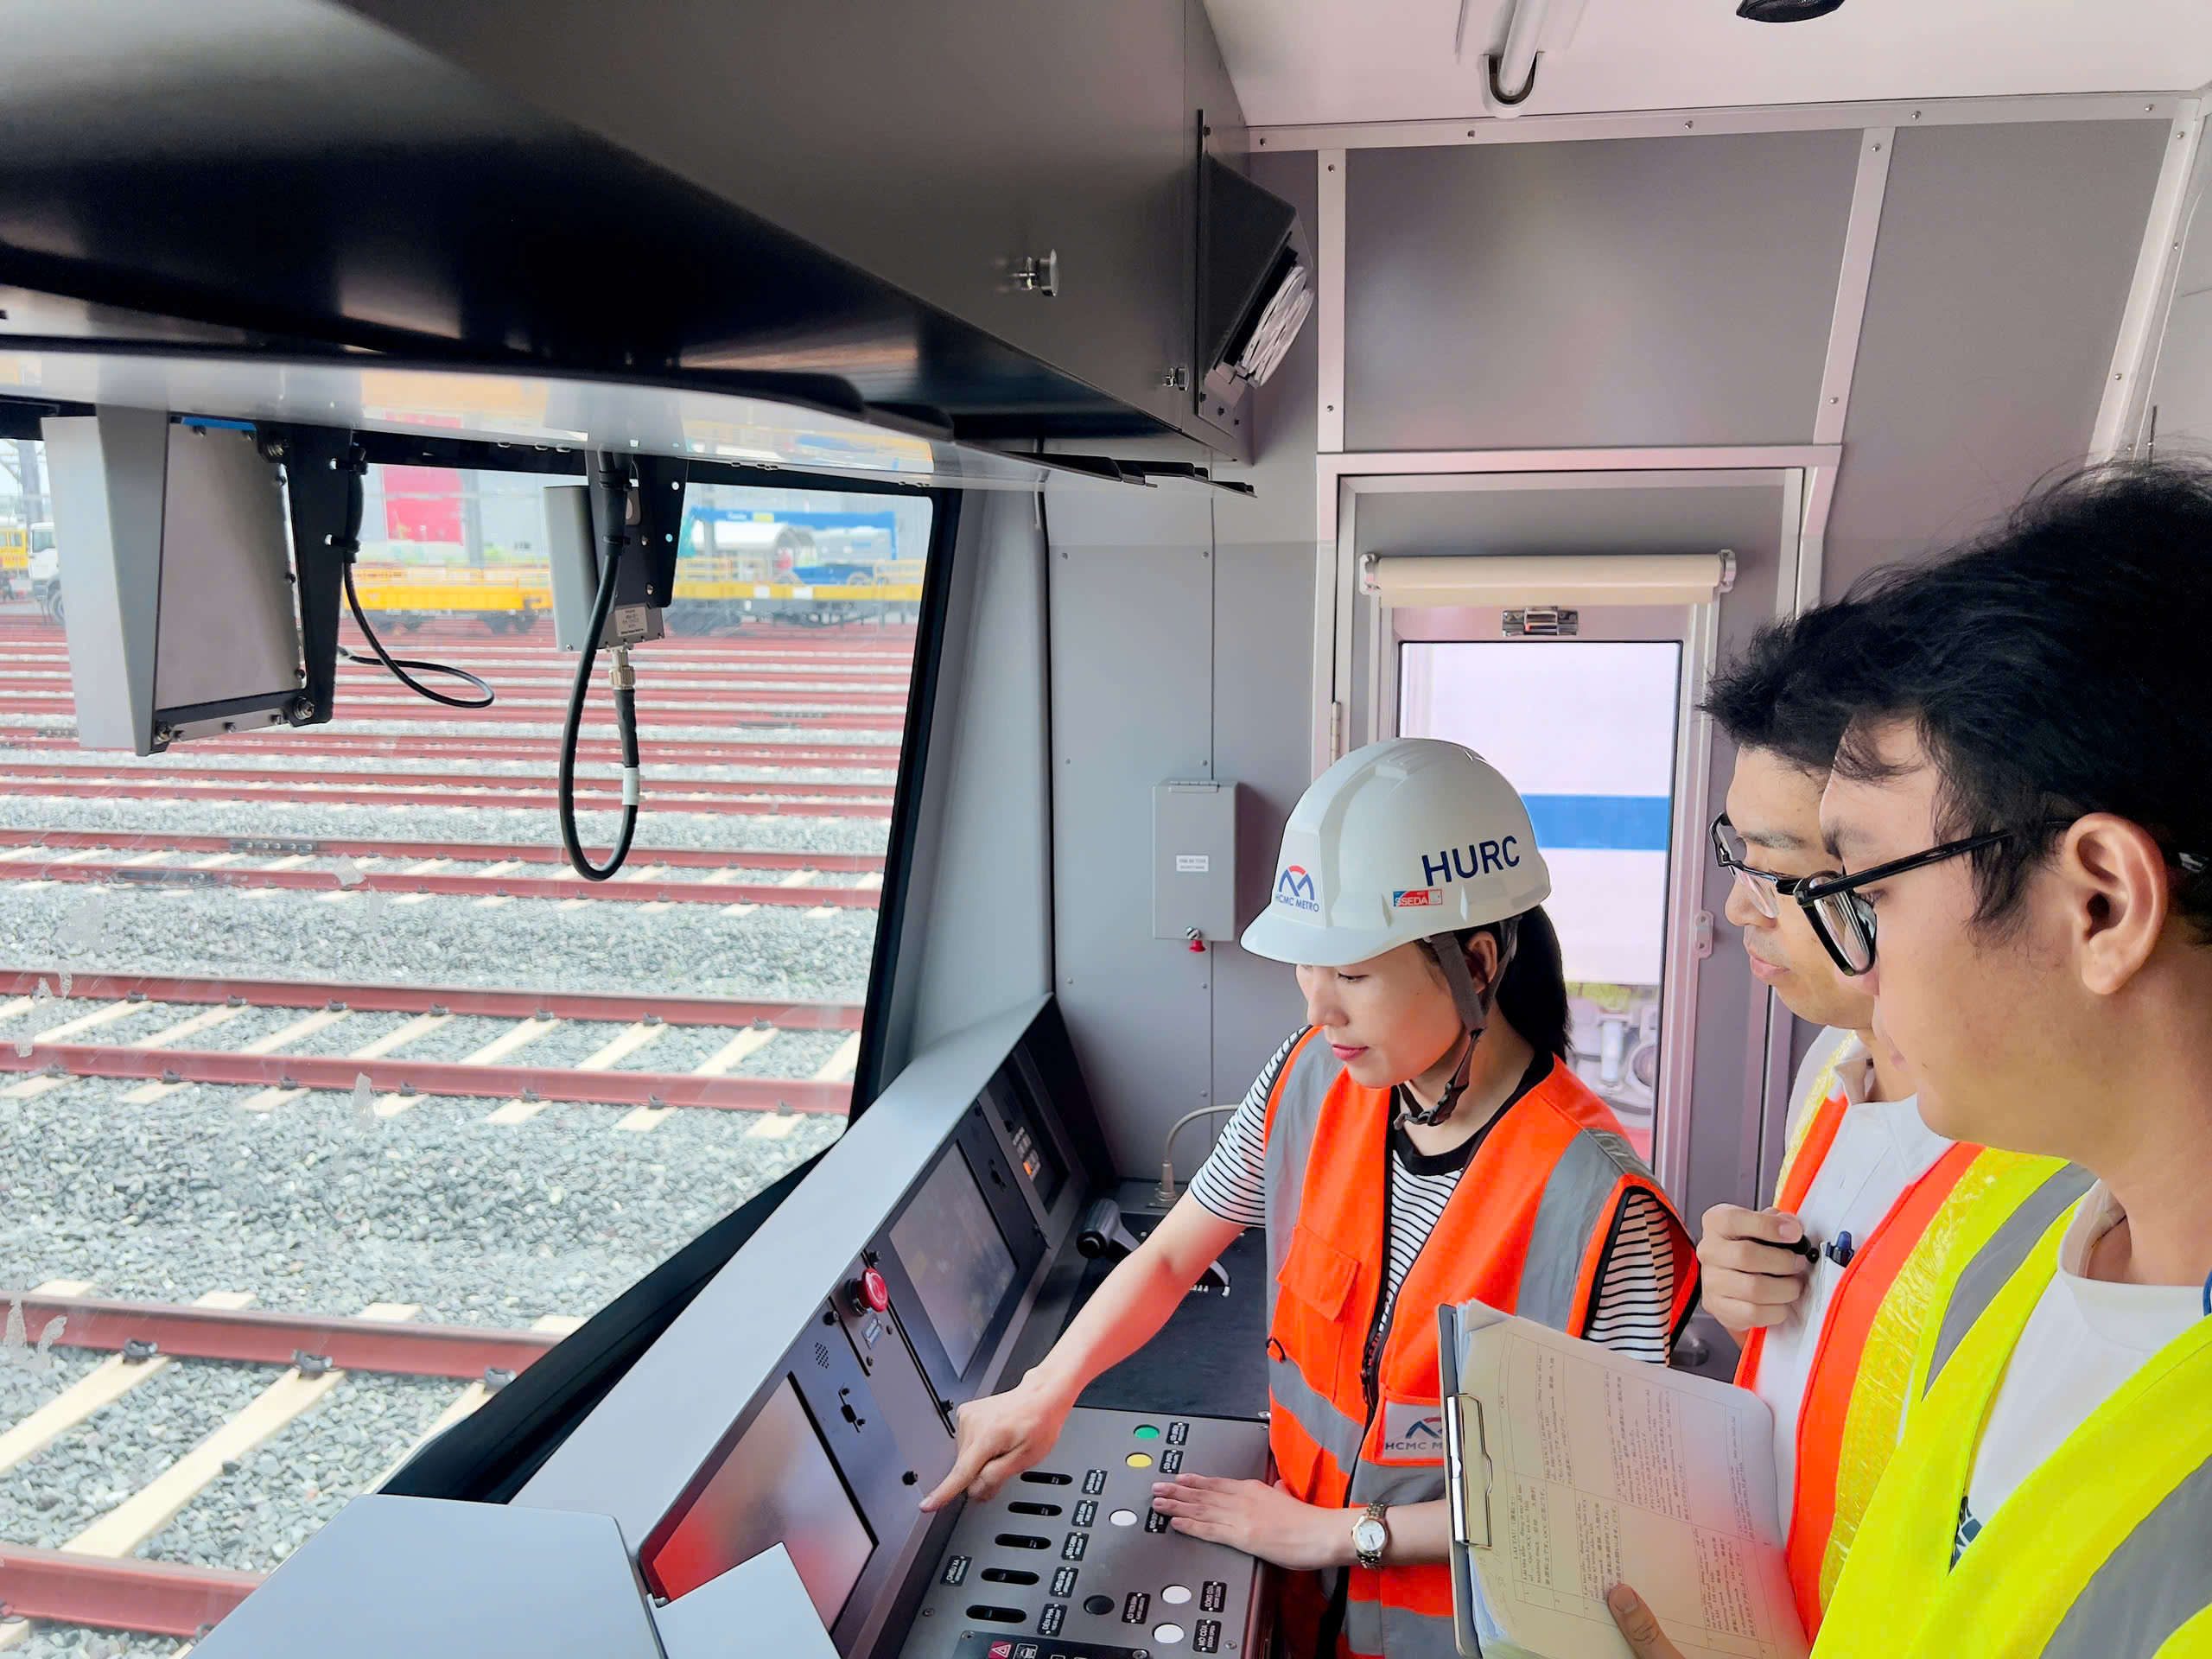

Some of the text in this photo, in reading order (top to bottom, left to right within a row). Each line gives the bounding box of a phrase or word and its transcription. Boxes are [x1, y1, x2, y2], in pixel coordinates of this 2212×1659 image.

[1421, 835, 1520, 887] HURC
[1275, 893, 1319, 912] HCMC METRO
